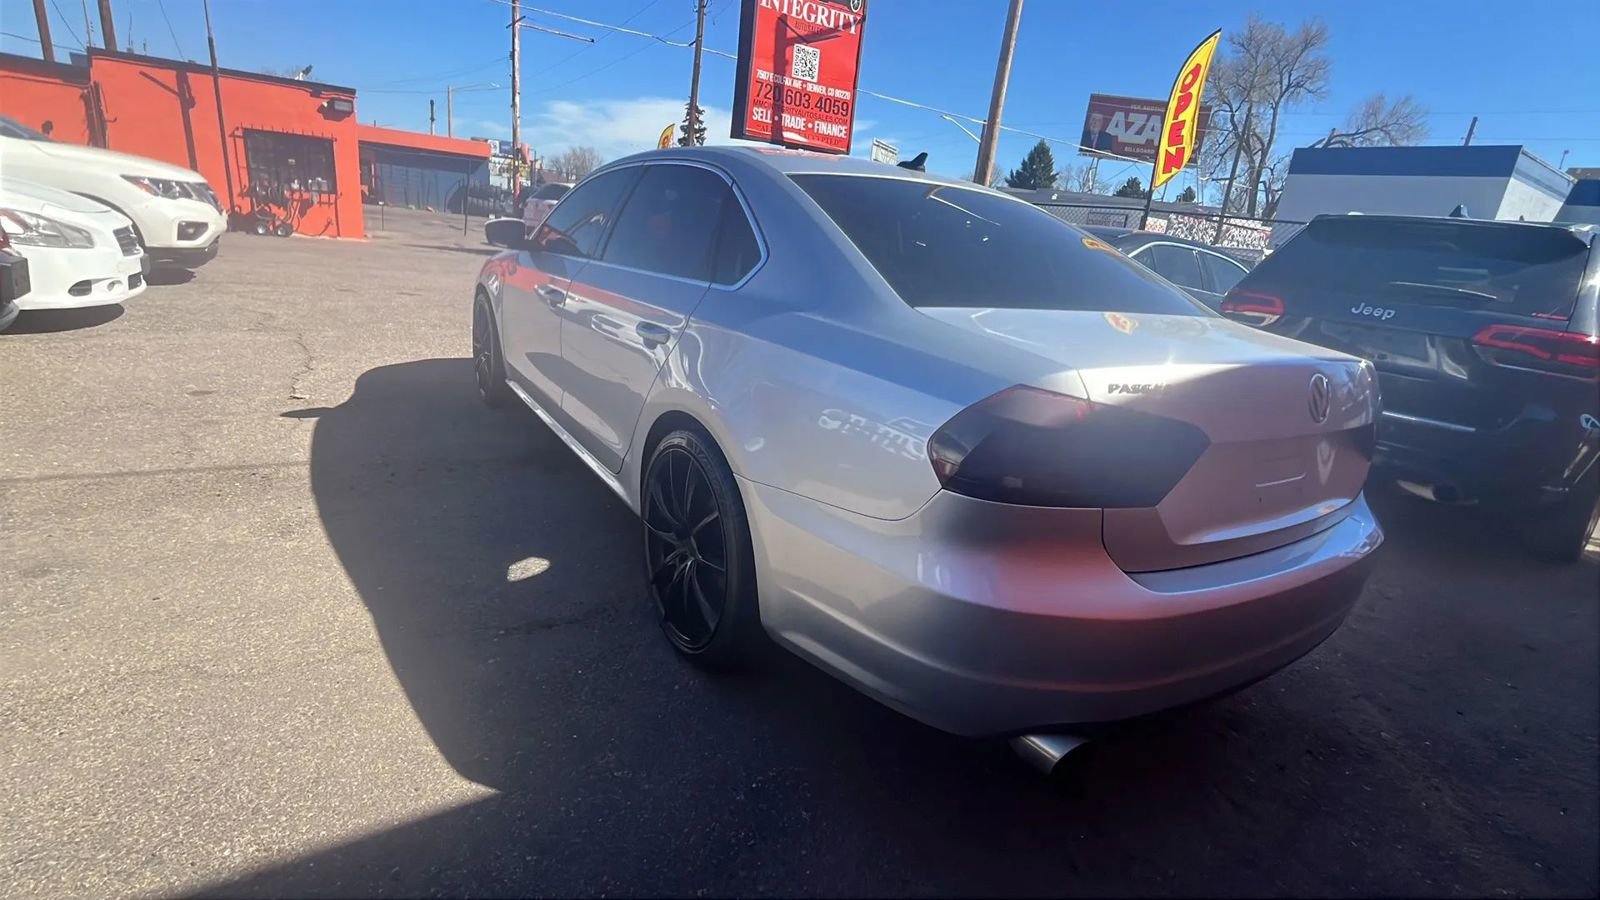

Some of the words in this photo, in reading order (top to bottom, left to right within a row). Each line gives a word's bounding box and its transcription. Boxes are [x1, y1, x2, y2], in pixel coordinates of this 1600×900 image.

[755, 81, 849, 117] 720.603.4059
[752, 107, 772, 124] SELL
[781, 113, 806, 131] TRADE
[814, 120, 848, 138] FINANCE
[1162, 63, 1202, 175] OPEN
[1351, 302, 1396, 320] Jeep
